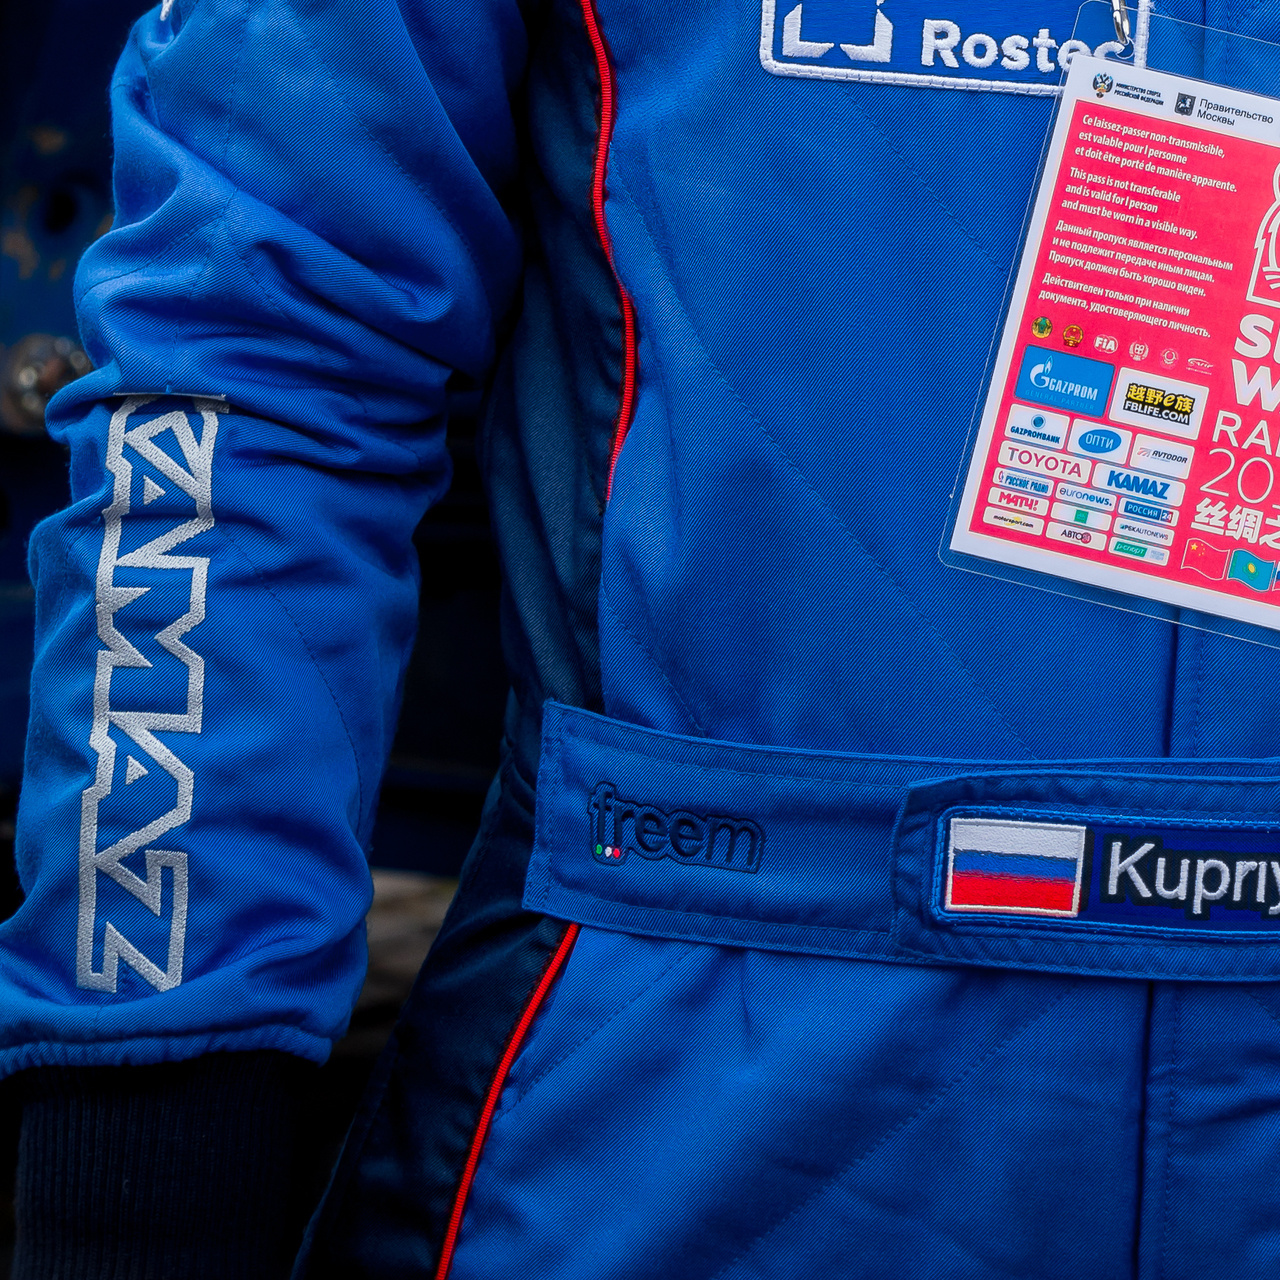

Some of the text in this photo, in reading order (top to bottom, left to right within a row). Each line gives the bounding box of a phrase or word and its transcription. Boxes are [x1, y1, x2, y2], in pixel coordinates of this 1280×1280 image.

[1197, 109, 1235, 127] Москвы
[1199, 98, 1274, 124] Правительство
[1078, 130, 1092, 142] est
[1092, 133, 1124, 149] valable
[1123, 142, 1144, 155] pour
[1148, 148, 1188, 165] personne
[1082, 114, 1226, 158] Ce laissez-passer non-transmissible,
[1070, 167, 1087, 180] This
[1086, 172, 1106, 186] pass
[1114, 179, 1129, 191] not
[1129, 182, 1181, 203] transferable
[1075, 147, 1238, 193] et doit être porté de manière apparente.
[1065, 183, 1082, 196] and
[1090, 189, 1112, 204] valid
[1111, 192, 1125, 205] for
[1128, 199, 1158, 214] person
[1061, 198, 1079, 211] and
[1078, 203, 1102, 217] must
[1101, 205, 1112, 219] be
[1113, 210, 1135, 224] worn
[1135, 214, 1145, 226] in
[1151, 218, 1178, 235] visible
[1178, 225, 1198, 241] way.
[1055, 219, 1234, 271] Данный пропуск является персональным
[1048, 249, 1206, 298] Пропуск должен быть хорошо виден.
[1059, 238, 1071, 248] не
[1070, 240, 1116, 259] подлежит
[1115, 251, 1158, 270] передаче
[1157, 260, 1184, 276] иным
[1183, 267, 1215, 284] лицам.
[1042, 272, 1191, 317] Действителен только при наличии
[1038, 289, 1211, 338] документа, удостоверяющего личность.
[1049, 375, 1099, 402] GAZPROM
[1124, 400, 1190, 425] FBLIFE.COM
[1010, 425, 1061, 445] GAZPROMBANK
[1085, 433, 1115, 450] ОПТИ
[1007, 446, 1082, 478] TOYOTA
[1151, 450, 1189, 464] AVTODOR
[1059, 487, 1113, 507] euronews.
[1107, 470, 1171, 500] KAMAZ
[998, 491, 1039, 512] МАТЧ!
[1127, 503, 1158, 518] РОССИЯ
[993, 513, 1034, 529] motorsport.com
[592, 787, 758, 867] freem
